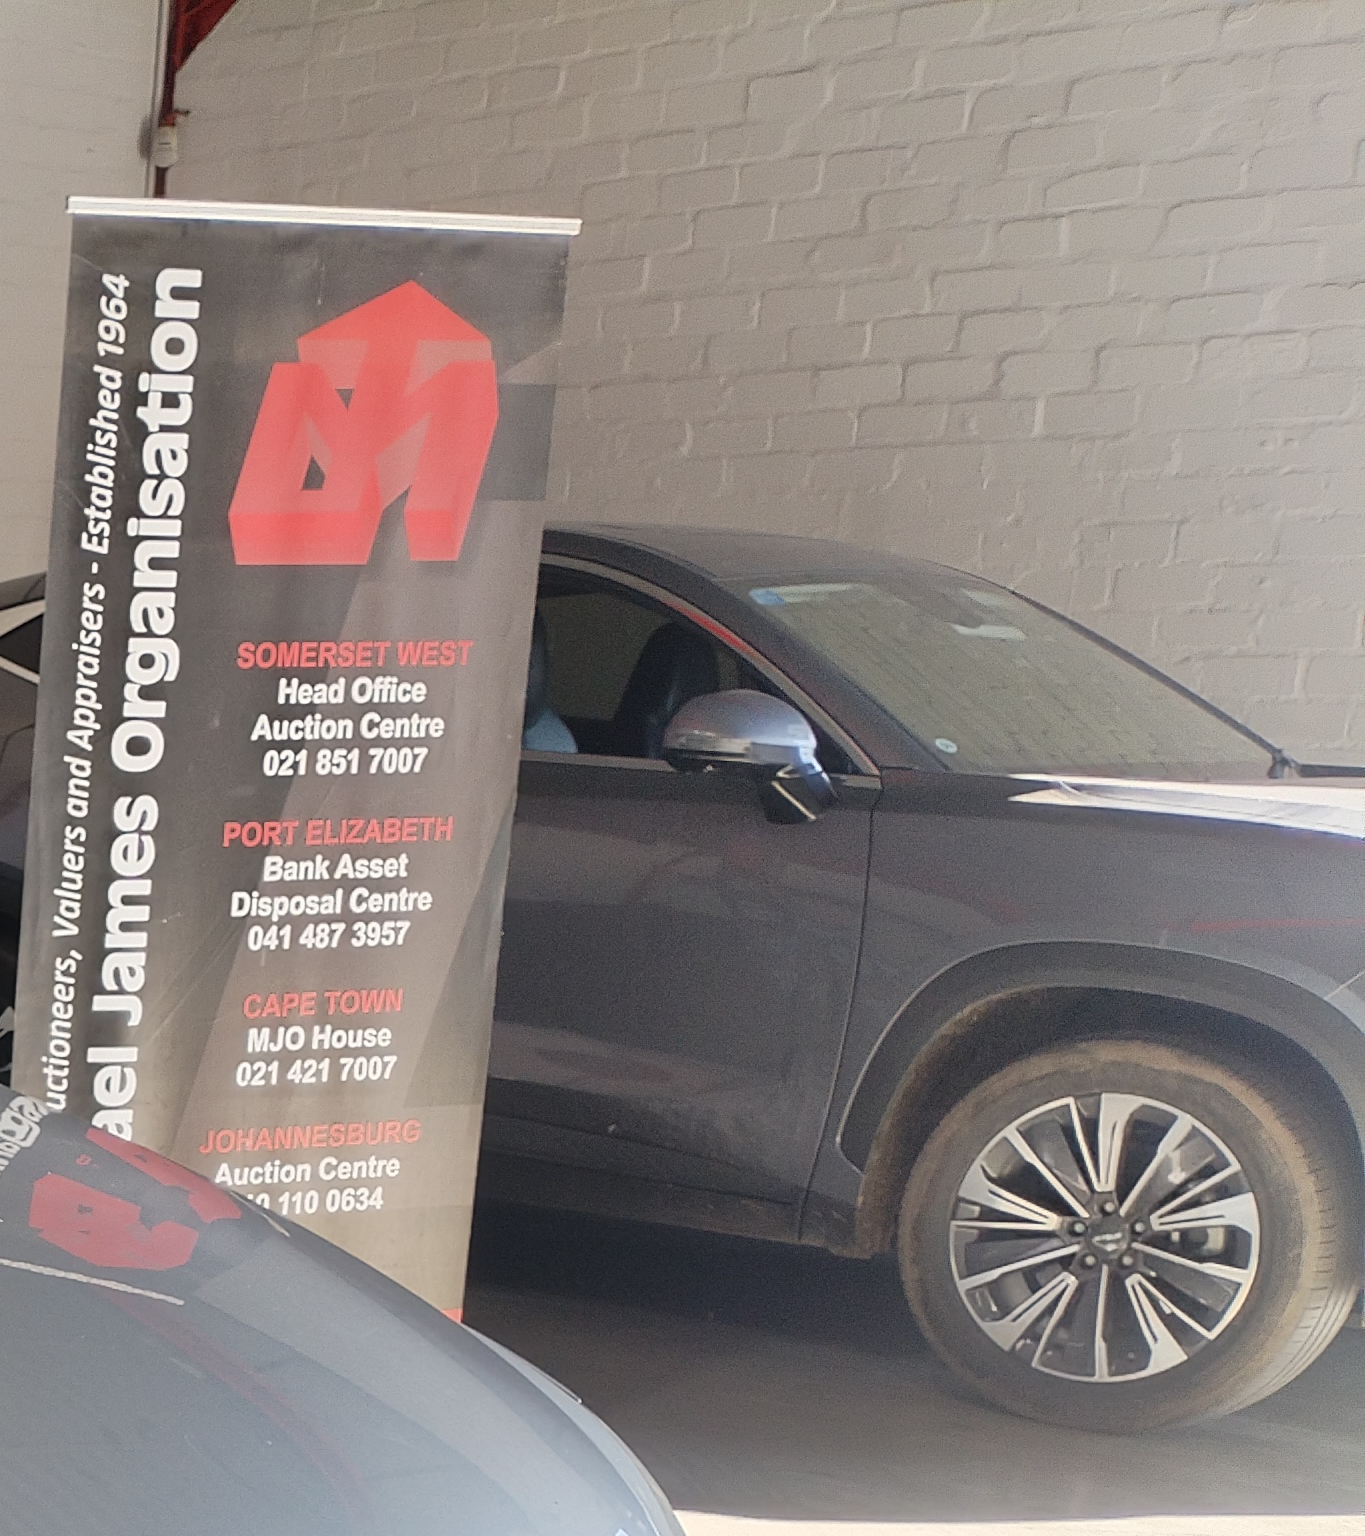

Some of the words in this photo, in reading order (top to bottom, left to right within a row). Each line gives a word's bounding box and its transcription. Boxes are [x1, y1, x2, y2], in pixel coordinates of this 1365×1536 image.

[97, 272, 131, 357] 1964
[80, 363, 123, 557] Established
[111, 267, 203, 774] Organisation
[66, 580, 107, 752] Appraisers
[235, 641, 390, 669] SOMERSET
[397, 639, 474, 666] WEST
[277, 677, 346, 705] Head
[351, 675, 427, 703] Office
[250, 713, 354, 742] Auction
[360, 711, 445, 739] Centre
[262, 748, 308, 777] 021
[315, 747, 361, 776] 851
[368, 746, 428, 774] 7007
[63, 756, 93, 818] and
[222, 820, 298, 848] PORT
[305, 815, 454, 846] ELIZABETH
[51, 824, 87, 938] Valuers
[263, 853, 330, 882] Bank
[334, 852, 409, 879] Asset
[91, 794, 159, 1027] James
[230, 888, 342, 920] Disposal
[349, 886, 433, 915] Centre
[247, 923, 292, 951] 041
[299, 922, 346, 949] 487
[351, 919, 411, 948] 3957
[242, 991, 317, 1019] CAPE
[324, 988, 403, 1016] TOWN
[41, 949, 83, 1110] uctioneers,
[246, 1025, 306, 1054] MJO
[311, 1022, 392, 1050] House
[235, 1060, 280, 1088] 021
[286, 1058, 331, 1085] 421
[339, 1055, 398, 1083] 7007
[198, 1119, 422, 1155] JOHANNESBURG
[214, 1160, 312, 1186] Auction
[319, 1155, 400, 1183] Centre
[278, 1190, 319, 1216] 110
[325, 1186, 384, 1213] 0634
